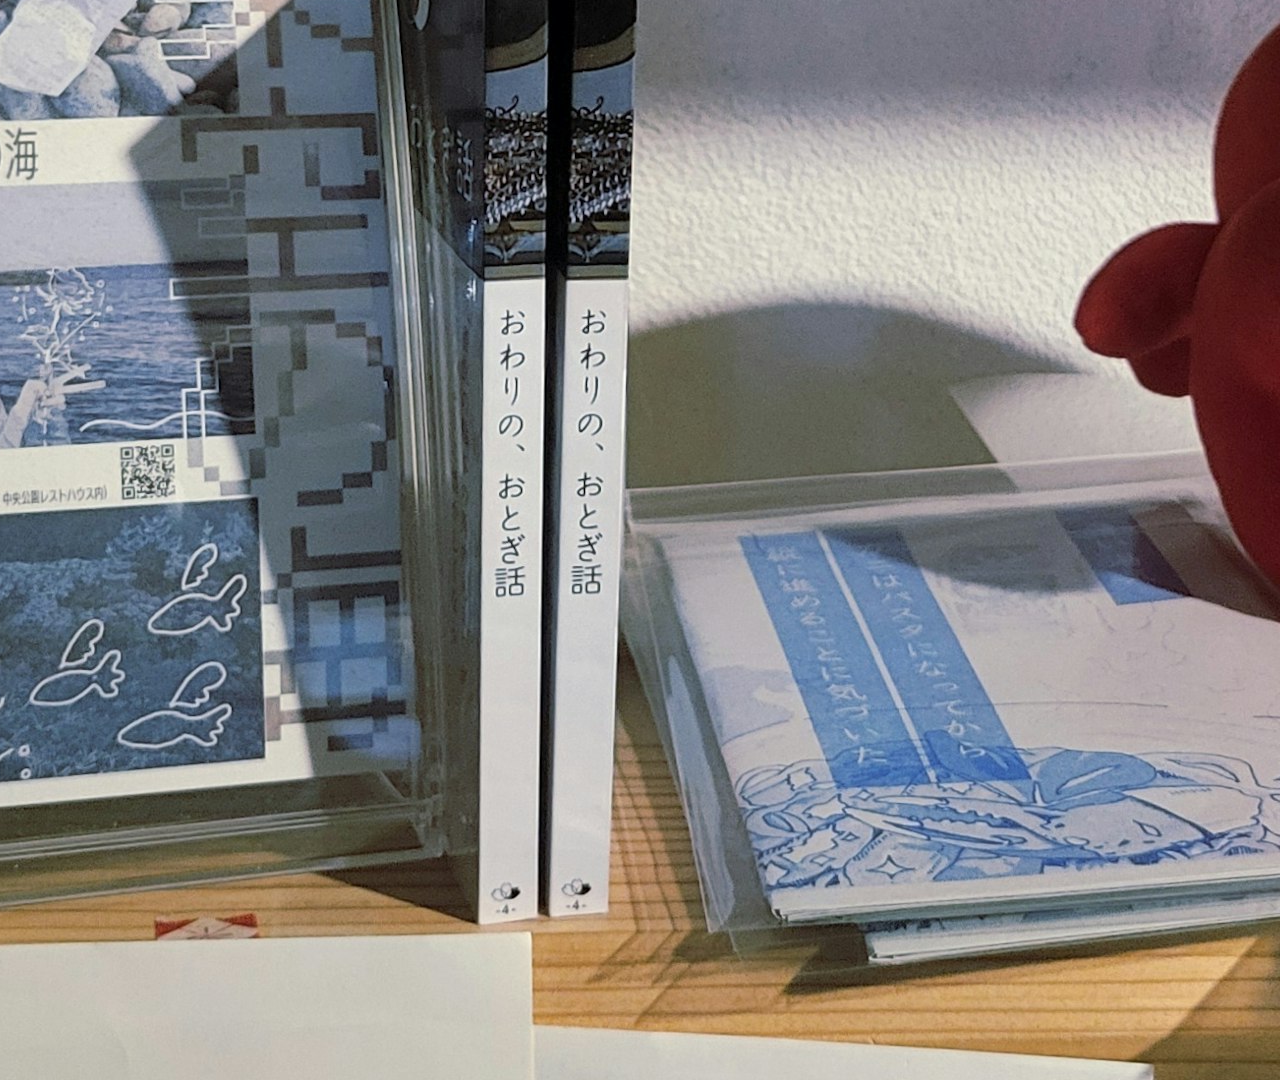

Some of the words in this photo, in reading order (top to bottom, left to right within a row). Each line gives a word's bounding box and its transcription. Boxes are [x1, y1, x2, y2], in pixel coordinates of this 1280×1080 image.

[866, 558, 1010, 770] ニはパスタになってから
